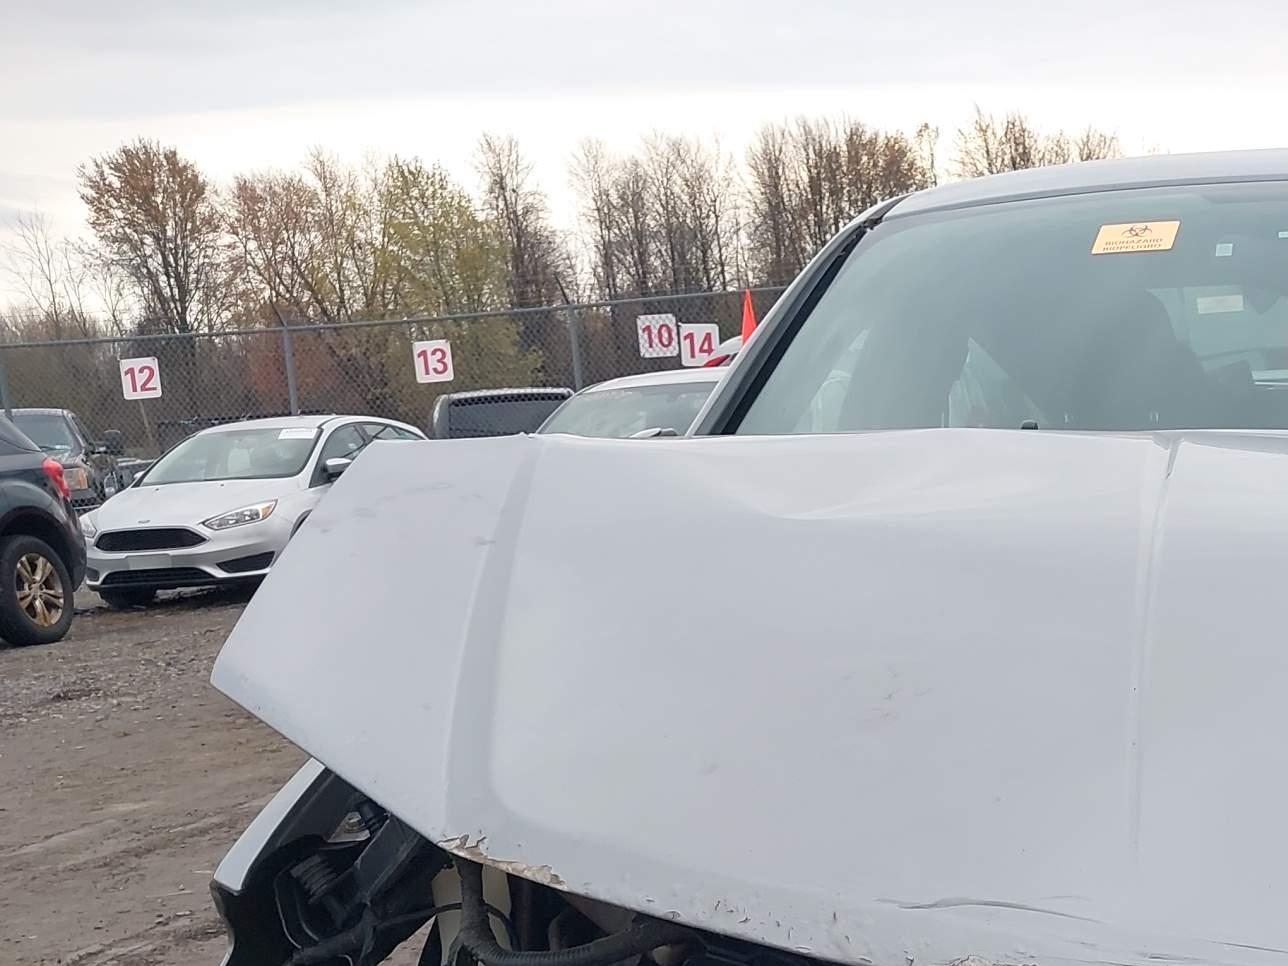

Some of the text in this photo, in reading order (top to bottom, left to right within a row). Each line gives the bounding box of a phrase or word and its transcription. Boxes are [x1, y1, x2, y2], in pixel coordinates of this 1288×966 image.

[642, 323, 673, 348] 10
[683, 332, 715, 359] 14
[416, 347, 449, 376] 13
[124, 365, 158, 393] 12
